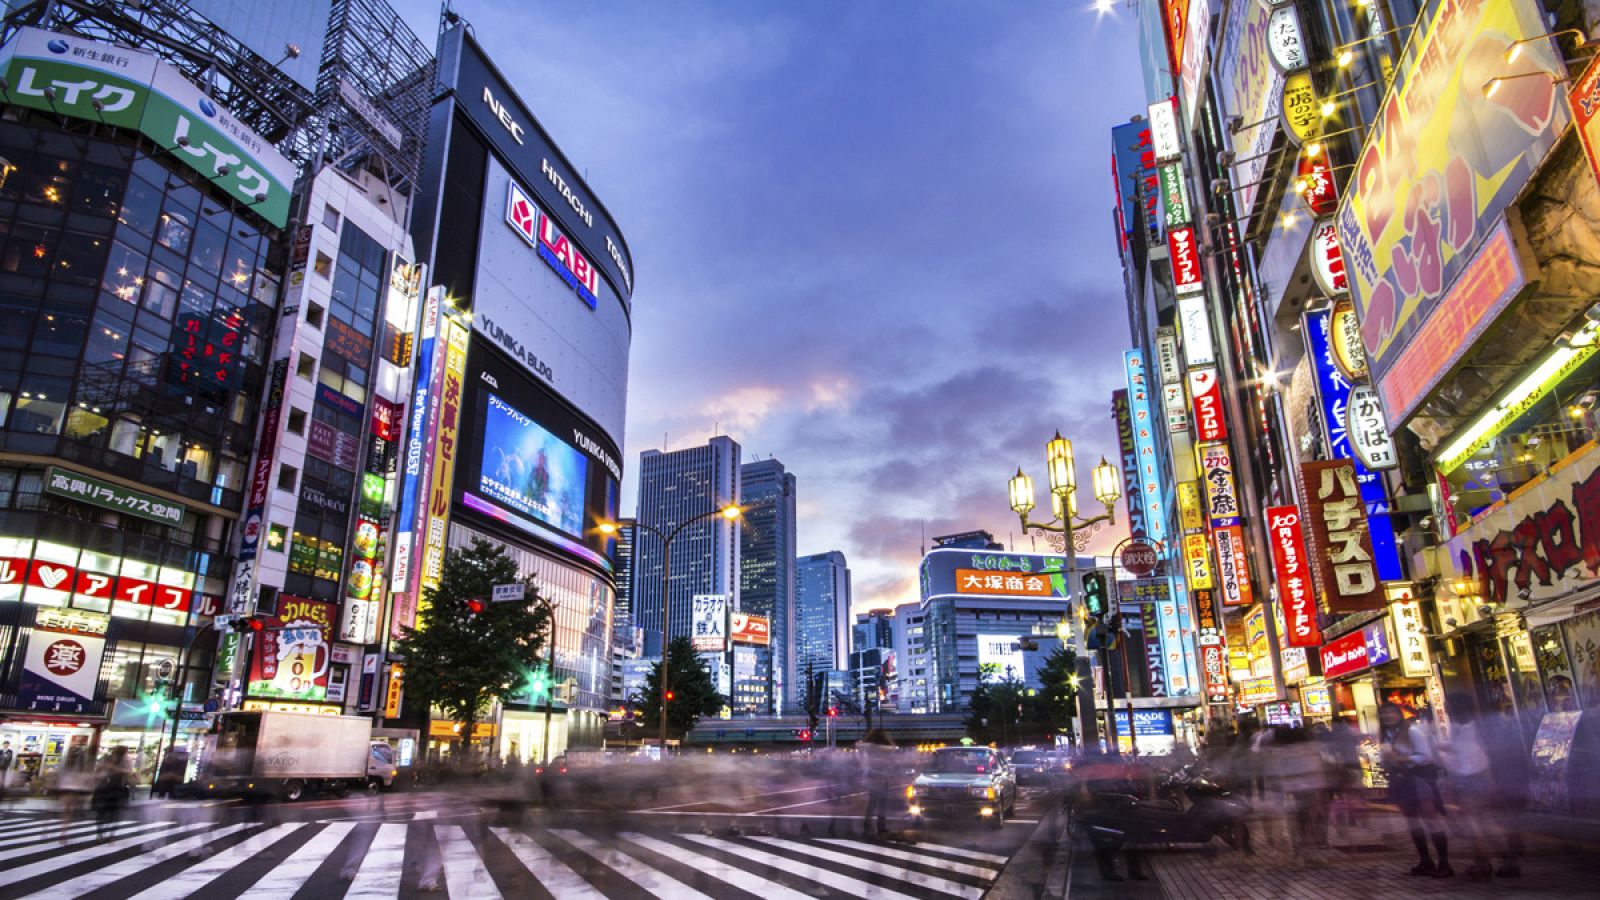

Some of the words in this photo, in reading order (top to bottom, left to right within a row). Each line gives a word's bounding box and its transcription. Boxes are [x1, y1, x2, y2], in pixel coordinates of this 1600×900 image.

[72, 46, 129, 68] 新生銀行
[16, 67, 135, 111] レイク
[218, 114, 262, 154] 新生銀行
[484, 86, 524, 145] NEC
[173, 114, 270, 200] レイク
[542, 157, 592, 228] HITACHI
[539, 213, 598, 298] LABI
[1176, 240, 1195, 284] アイフル
[481, 314, 526, 361] YUNIKA
[527, 352, 554, 383] BLDG.
[489, 395, 531, 427] クリープハイプ
[1200, 396, 1218, 429] アコム
[1359, 401, 1389, 447] かっぱ
[573, 428, 605, 464] YUNIKA
[1206, 430, 1219, 438] 3F
[1205, 457, 1229, 468] 270
[1370, 451, 1391, 462] B1
[51, 473, 181, 522] 高興リラックス空間
[1207, 467, 1237, 514] 金の蔵
[1357, 474, 1376, 483] 3F
[1318, 465, 1376, 596] パチスロ
[971, 554, 1032, 572] たのめーる
[1124, 552, 1154, 565] 消火栓
[1218, 531, 1238, 600] 東京チカラめし
[84, 573, 217, 616] アイフル
[963, 575, 1044, 592] 大塚商会
[695, 597, 724, 612] カラオケ
[696, 621, 721, 635] 鉄人
[1163, 607, 1184, 687] ラオケ館
[48, 643, 83, 671] 薬
[1147, 644, 1167, 696] エスパス
[36, 694, 55, 702] MINE
[1115, 711, 1164, 722] SUNADE
